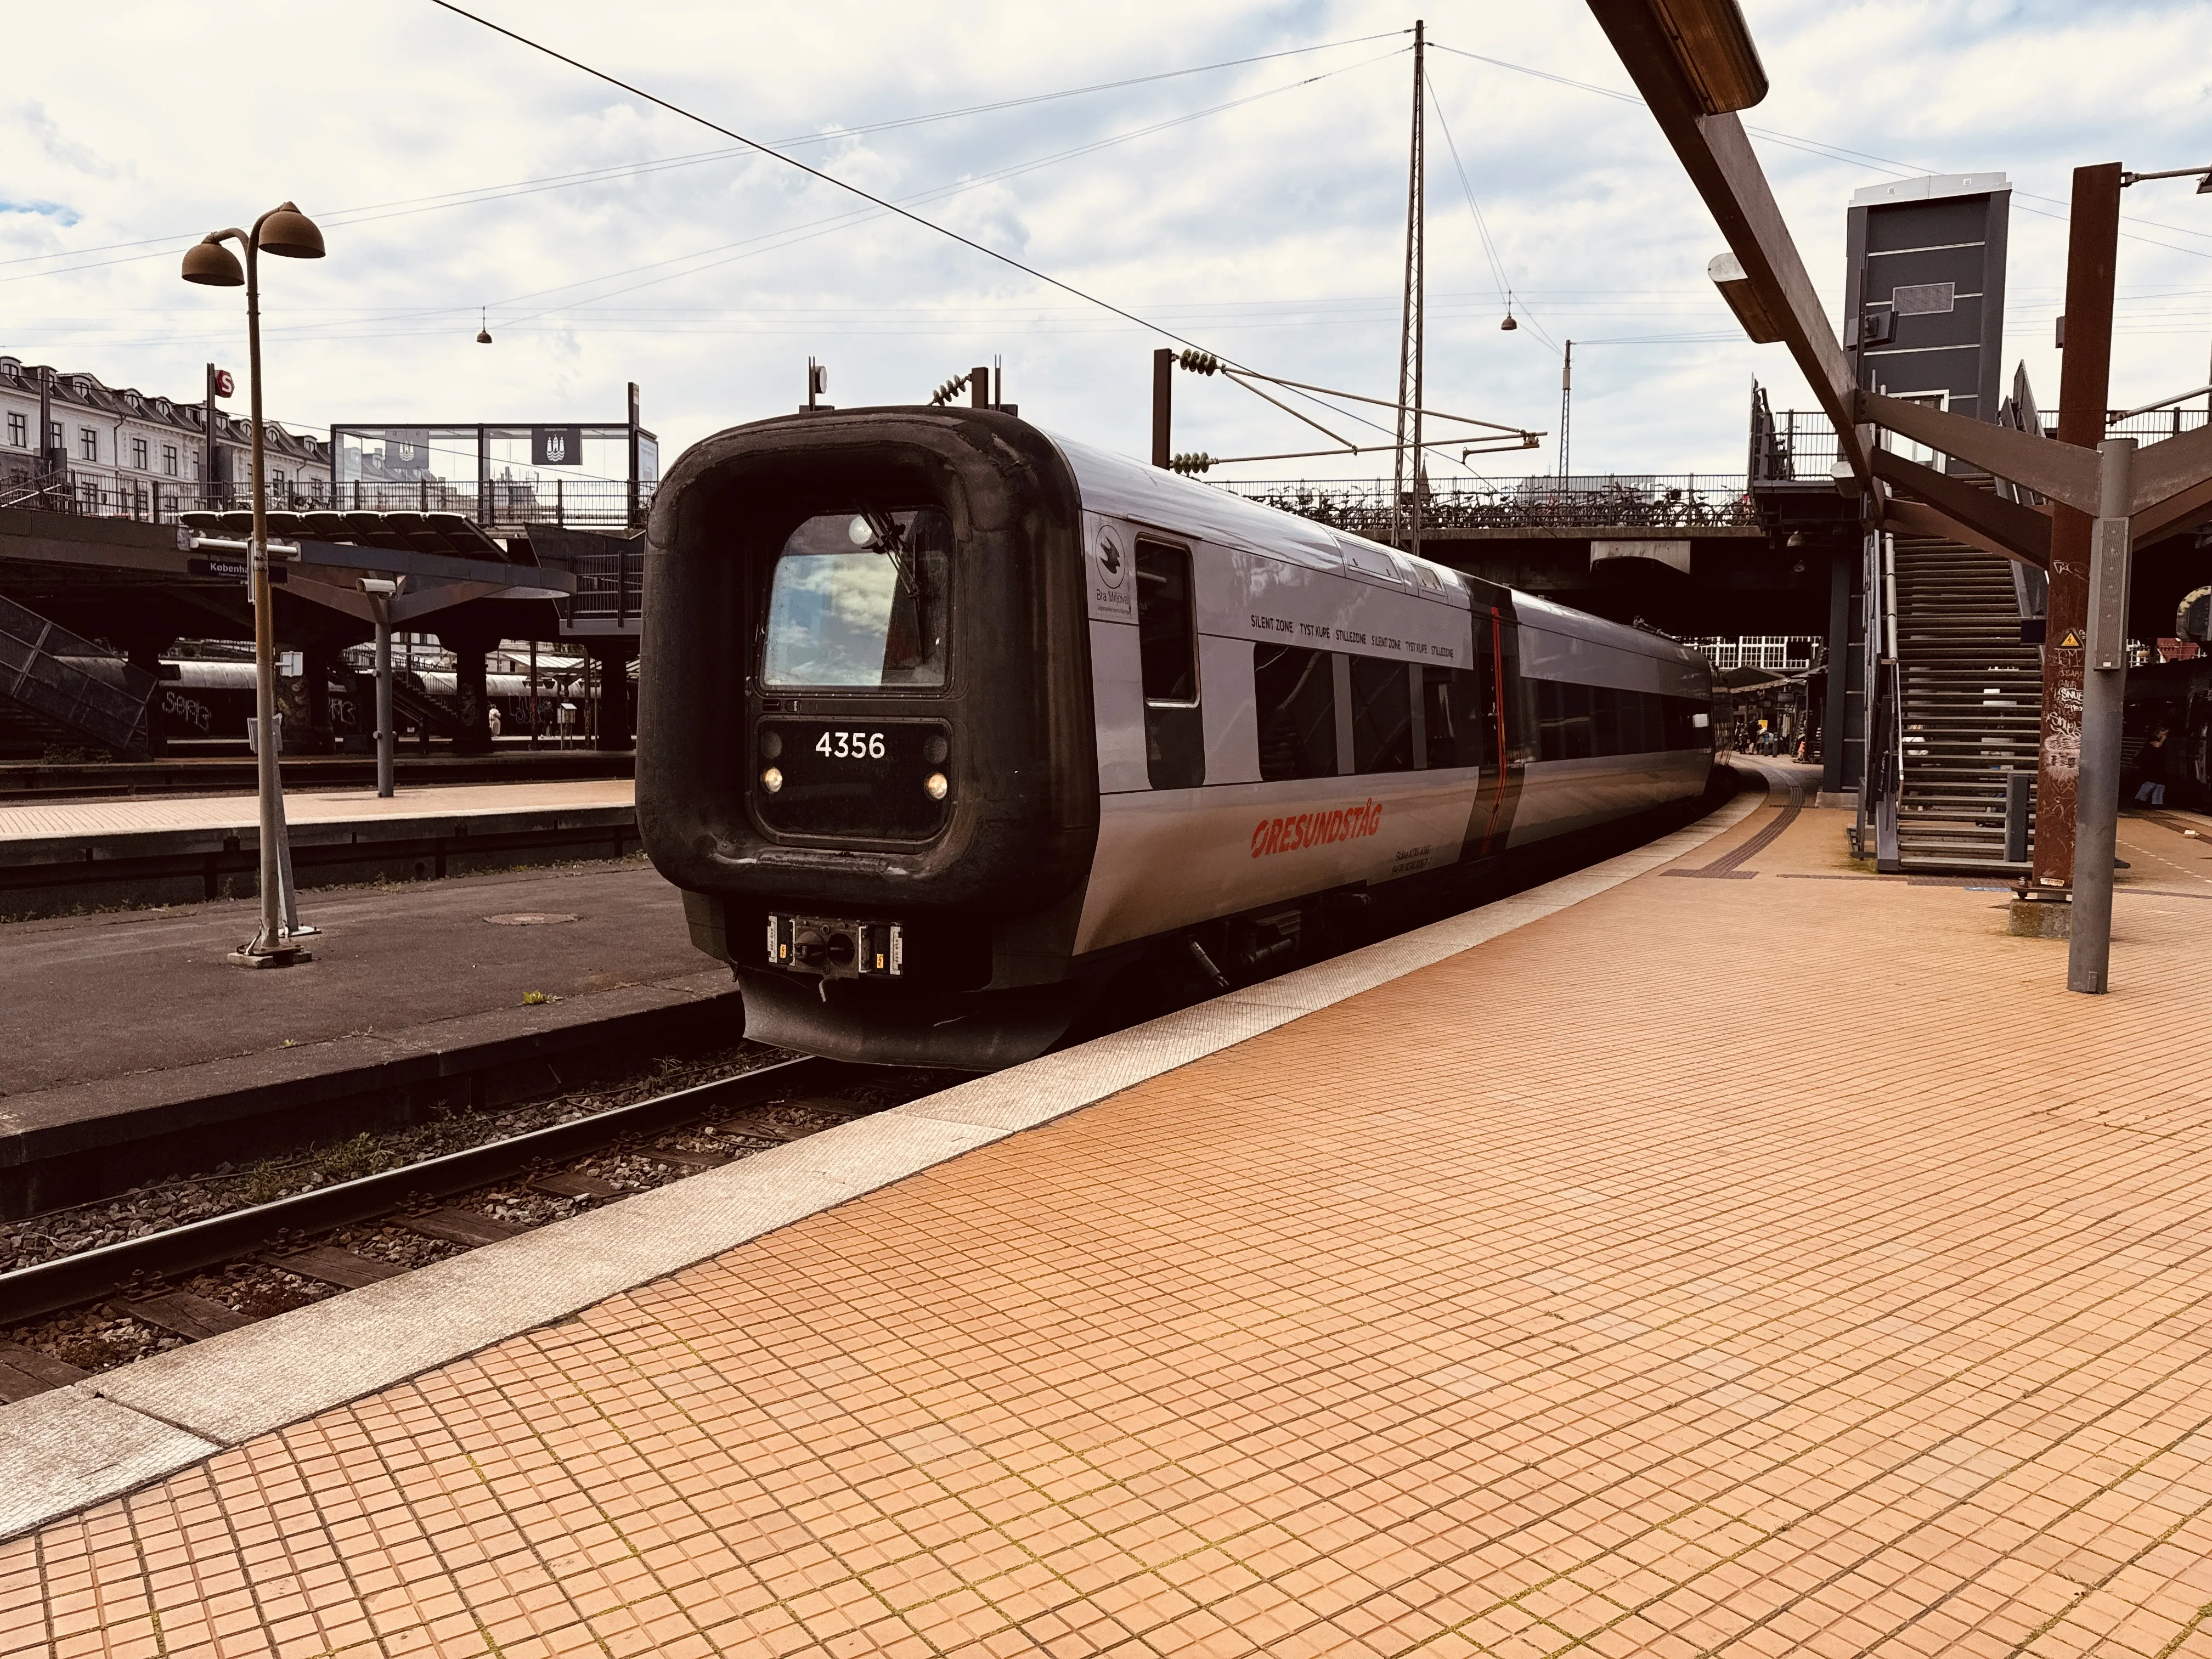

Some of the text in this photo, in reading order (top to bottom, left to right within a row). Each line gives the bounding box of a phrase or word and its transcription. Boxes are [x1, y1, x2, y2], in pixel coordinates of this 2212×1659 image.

[222, 375, 232, 393] S
[210, 562, 247, 573] Københa
[1097, 589, 1107, 602] Bra
[1251, 614, 1274, 630] SILENT
[1276, 619, 1294, 633] ZONE
[1300, 623, 1314, 636] TYST
[1336, 629, 1367, 645] STILLEZONE
[1372, 635, 1387, 648] SILENT
[1389, 638, 1401, 650] ZONE
[1405, 641, 1415, 652] TYST
[815, 731, 885, 759] 4356
